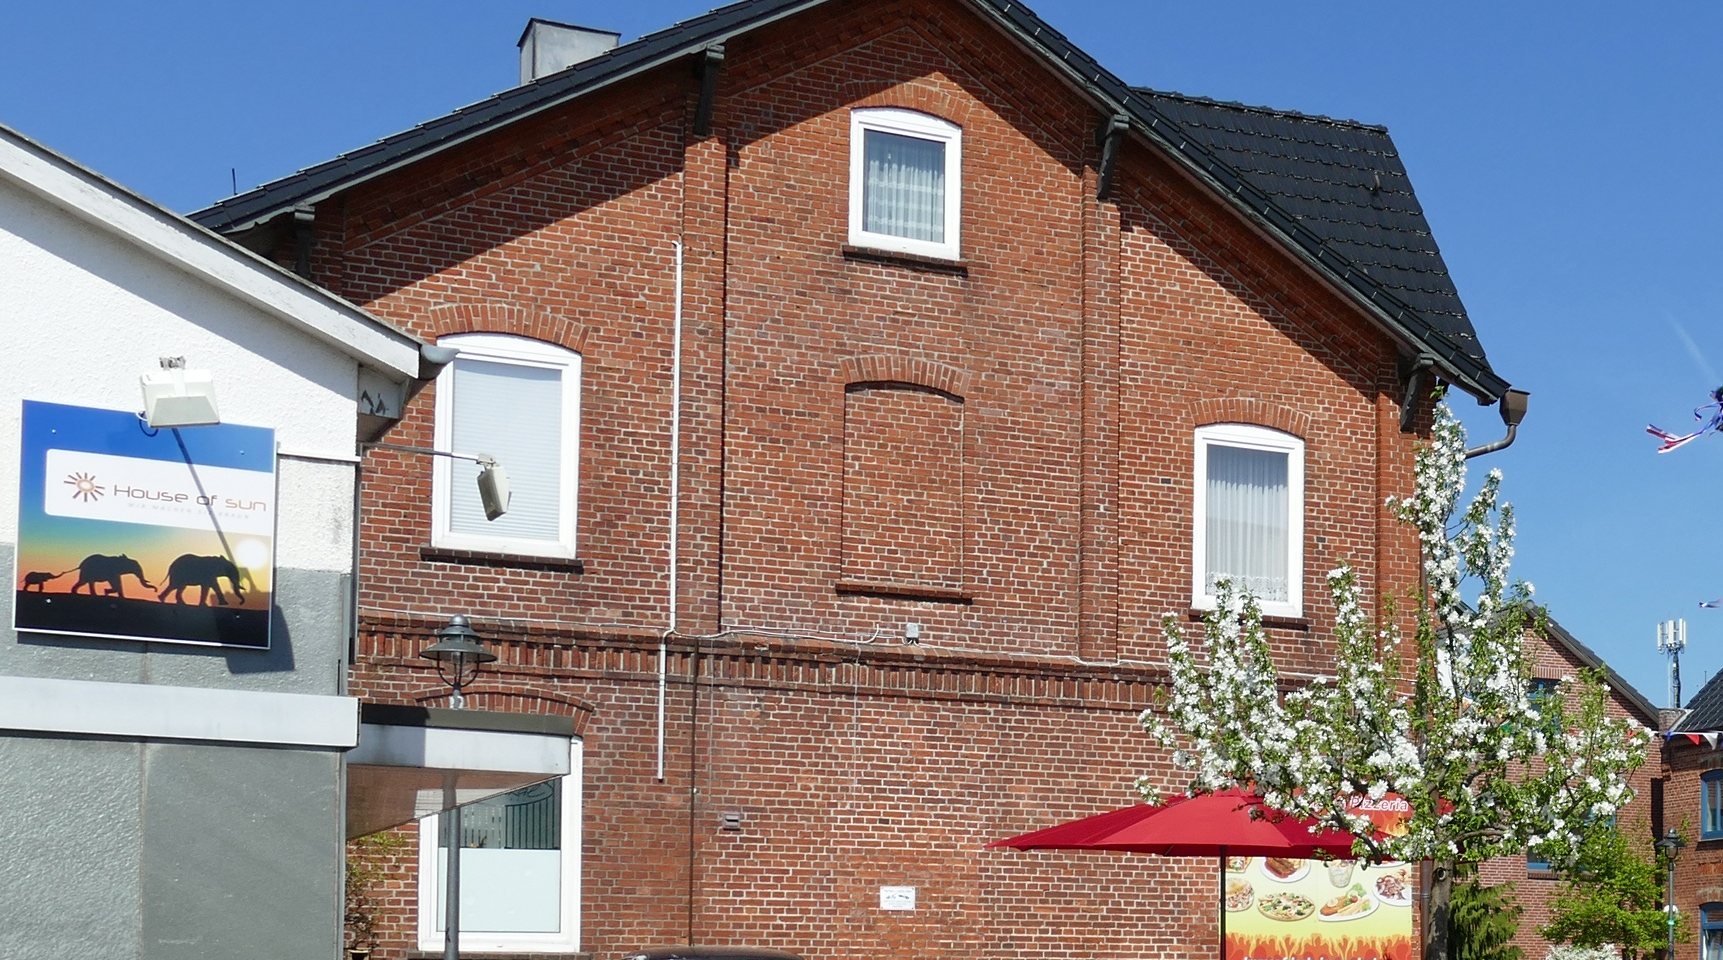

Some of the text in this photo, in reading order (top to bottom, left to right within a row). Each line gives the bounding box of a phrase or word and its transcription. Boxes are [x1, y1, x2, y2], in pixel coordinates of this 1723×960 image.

[113, 484, 267, 512] House of sun
[152, 504, 192, 513] MACHEN
[1349, 796, 1409, 812] Pizzeria
